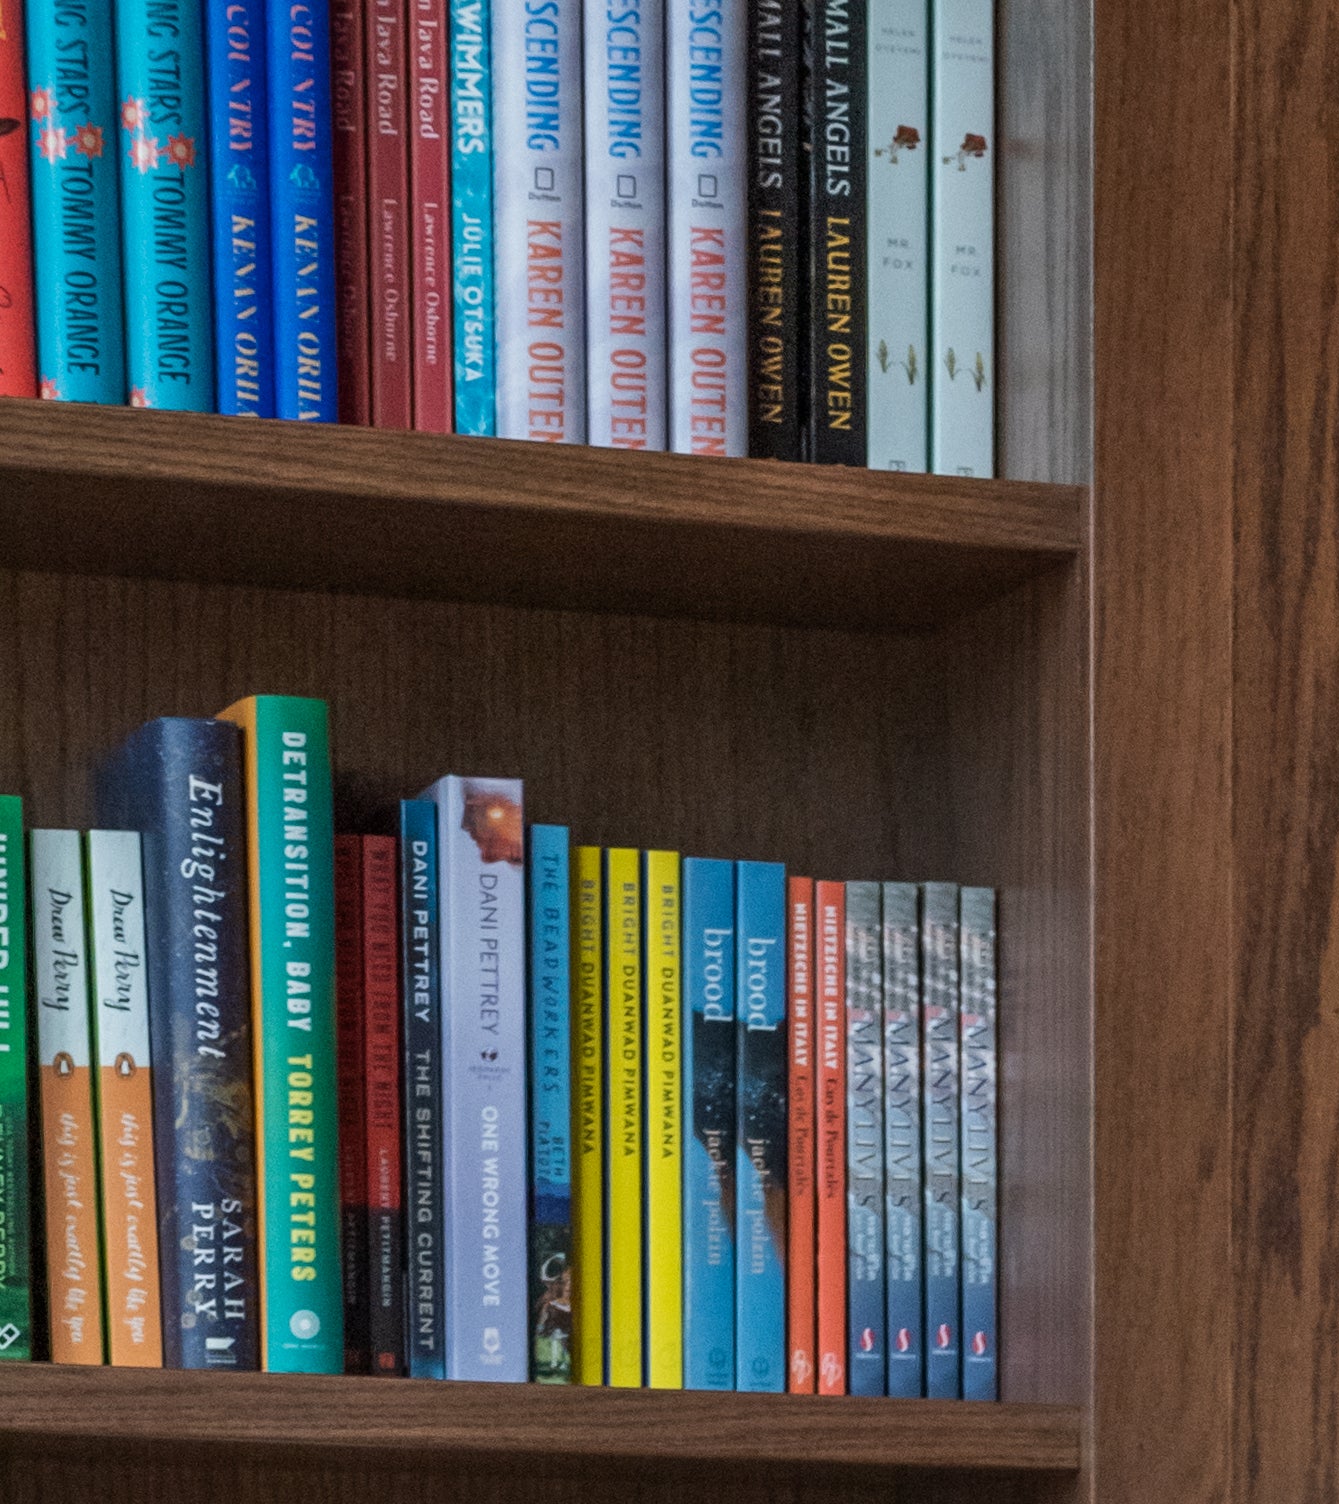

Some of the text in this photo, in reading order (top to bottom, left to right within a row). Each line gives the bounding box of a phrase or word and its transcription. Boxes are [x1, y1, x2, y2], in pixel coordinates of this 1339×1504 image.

[419, 77, 440, 139] Road
[55, 39, 99, 376] STARS TOMMY ORANGE
[148, 50, 191, 385] STARS TOMMY ORANGE
[527, 219, 564, 329] KAREN
[826, 78, 852, 431] ANGELS LAUREN OWEN
[462, 213, 485, 382] JULIE OTSUKA
[104, 888, 140, 1012] Drew Perry
[180, 773, 230, 1058] Enlightenment
[541, 855, 559, 900] THE
[281, 731, 316, 1282] DETRANSITION, BABY TORREY PETERS
[661, 885, 675, 1160] BRIGHT DUANWAD PIMWANA
[747, 937, 778, 1032] brood
[825, 1015, 839, 1069] ITALY
[412, 840, 435, 1350] DANI PETTREY THE SHIFTING CURRENT
[479, 873, 501, 1308] DANI PETTREY ONE WRONG MOVE
[191, 1200, 218, 1321] PERRY
[219, 1198, 245, 1321] SARAH
